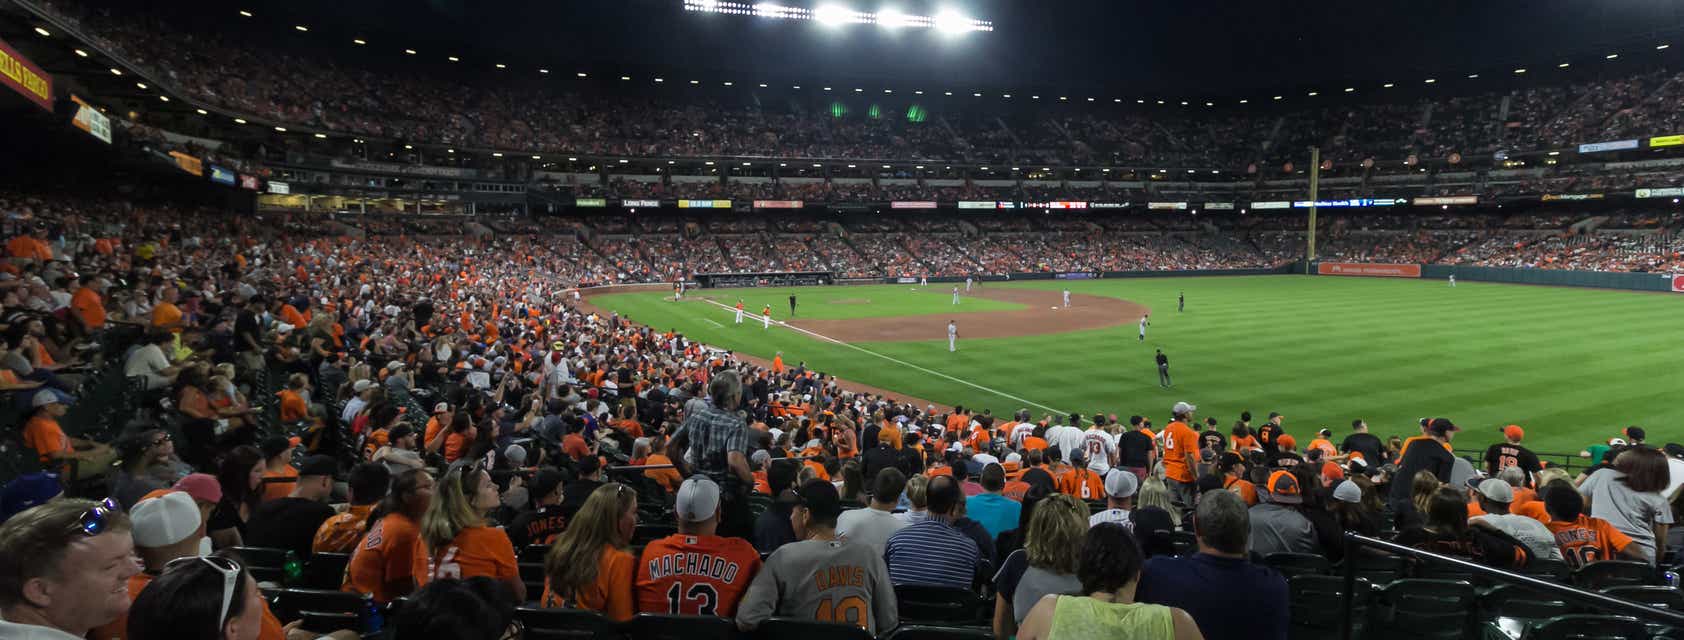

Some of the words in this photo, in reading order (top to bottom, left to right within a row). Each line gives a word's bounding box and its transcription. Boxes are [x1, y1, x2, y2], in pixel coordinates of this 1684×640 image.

[1165, 431, 1175, 449] 6
[1081, 479, 1090, 499] 6
[649, 552, 740, 584] MACHADO
[815, 565, 866, 592] DAVIS
[667, 581, 719, 616] 13
